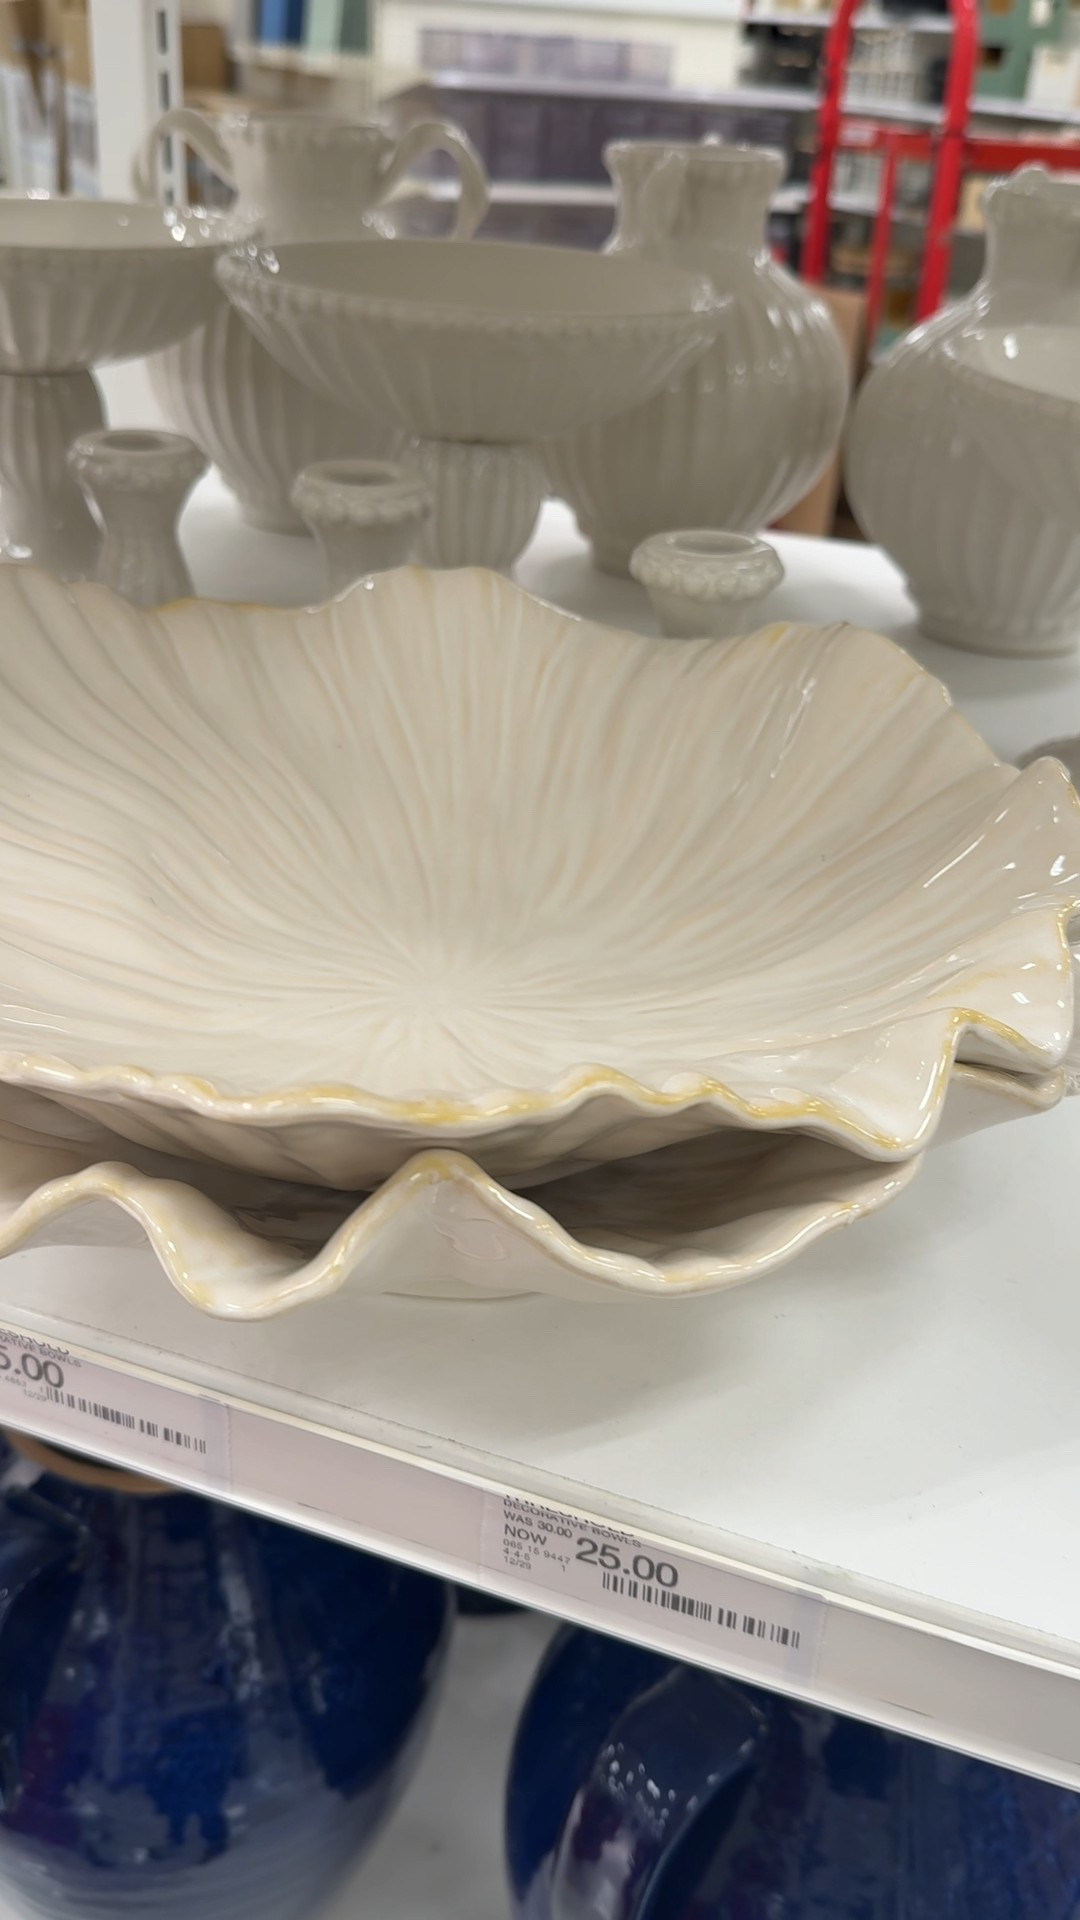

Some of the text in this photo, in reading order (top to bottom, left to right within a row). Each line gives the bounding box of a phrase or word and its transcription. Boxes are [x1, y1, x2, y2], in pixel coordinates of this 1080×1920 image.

[503, 1499, 587, 1531] DECORATIVE
[592, 1527, 642, 1548] BOWLS
[503, 1509, 533, 1527] WAS
[537, 1520, 573, 1539] 30.00
[504, 1523, 547, 1545] NOW
[503, 1538, 523, 1550] 065
[543, 1550, 570, 1564] 9447
[504, 1556, 532, 1570] 12/29
[575, 1537, 679, 1588] 25.00
